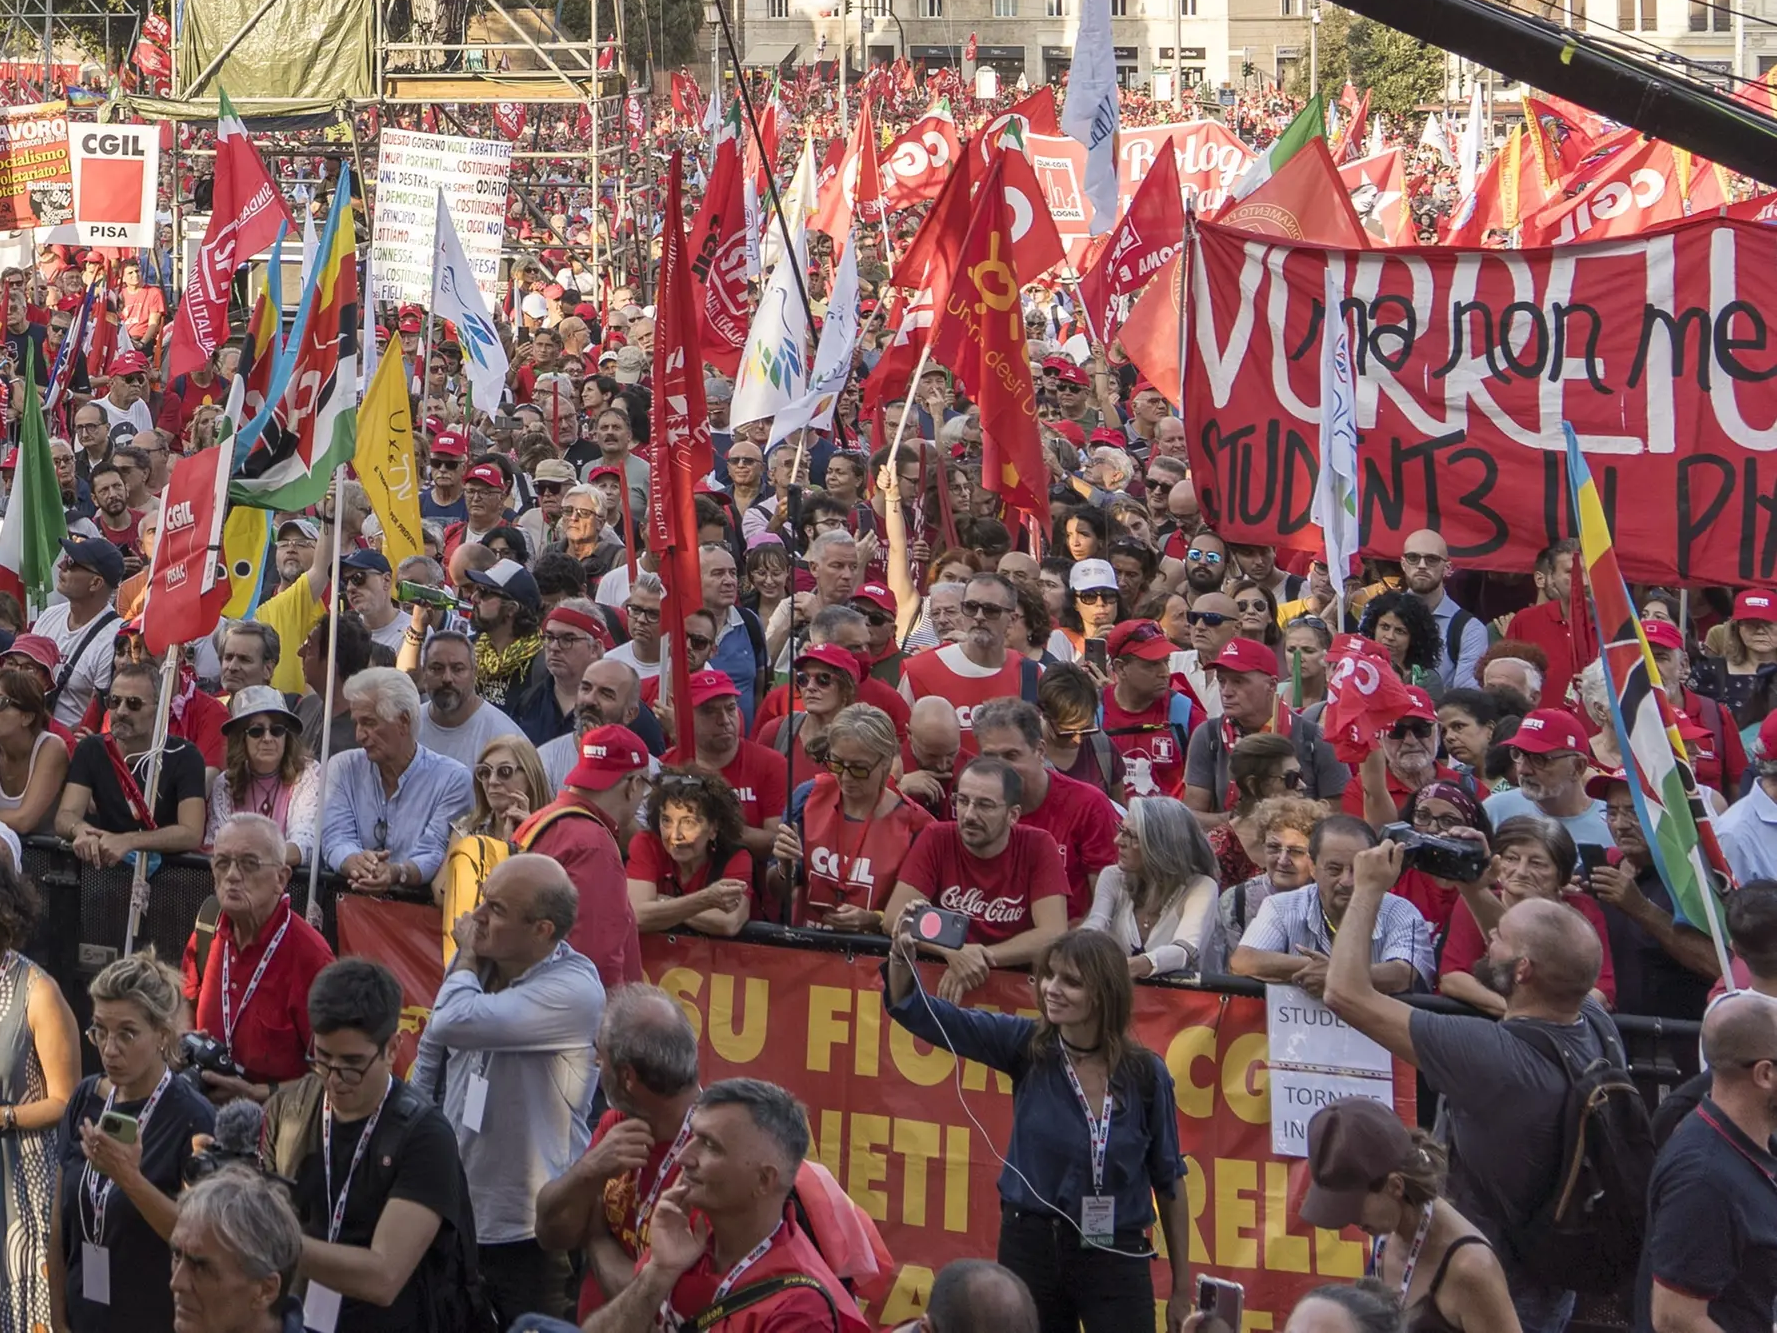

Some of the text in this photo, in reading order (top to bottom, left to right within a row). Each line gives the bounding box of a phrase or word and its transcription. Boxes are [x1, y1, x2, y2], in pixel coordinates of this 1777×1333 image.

[11, 137, 43, 153] pensioni
[81, 132, 146, 157] CGIL
[382, 131, 512, 159] QUESTO GOVERNO VUOLE ABBATTERE
[58, 158, 71, 175] al
[384, 150, 404, 165] MURI
[404, 153, 443, 171] PORTANTI
[456, 158, 510, 179] COSTITUZIONE
[26, 180, 73, 192] Buttiamo
[379, 169, 397, 184] UNA
[398, 171, 429, 188] DESTRA
[452, 182, 475, 194] SEMPRE
[476, 179, 507, 197] ODIATO
[50, 190, 72, 207] giù
[385, 190, 435, 209] DEMOCRAZIA
[455, 197, 506, 217] COSTITUZIONE
[90, 225, 129, 239] PISA
[374, 225, 409, 244] LOTTIAMO
[382, 208, 502, 236] PRINCIPIO OGGI NOI
[373, 247, 413, 264] CONNESSA
[382, 284, 403, 300] FIGLI
[1431, 298, 1616, 395] non
[984, 349, 1027, 395] degli
[165, 499, 195, 531] CGIL
[164, 566, 188, 585] FISAC
[940, 885, 1026, 924] Bella Ciao
[655, 966, 771, 1065] SU
[1164, 1023, 1270, 1126] CG
[697, 1304, 724, 1328] Nikon
